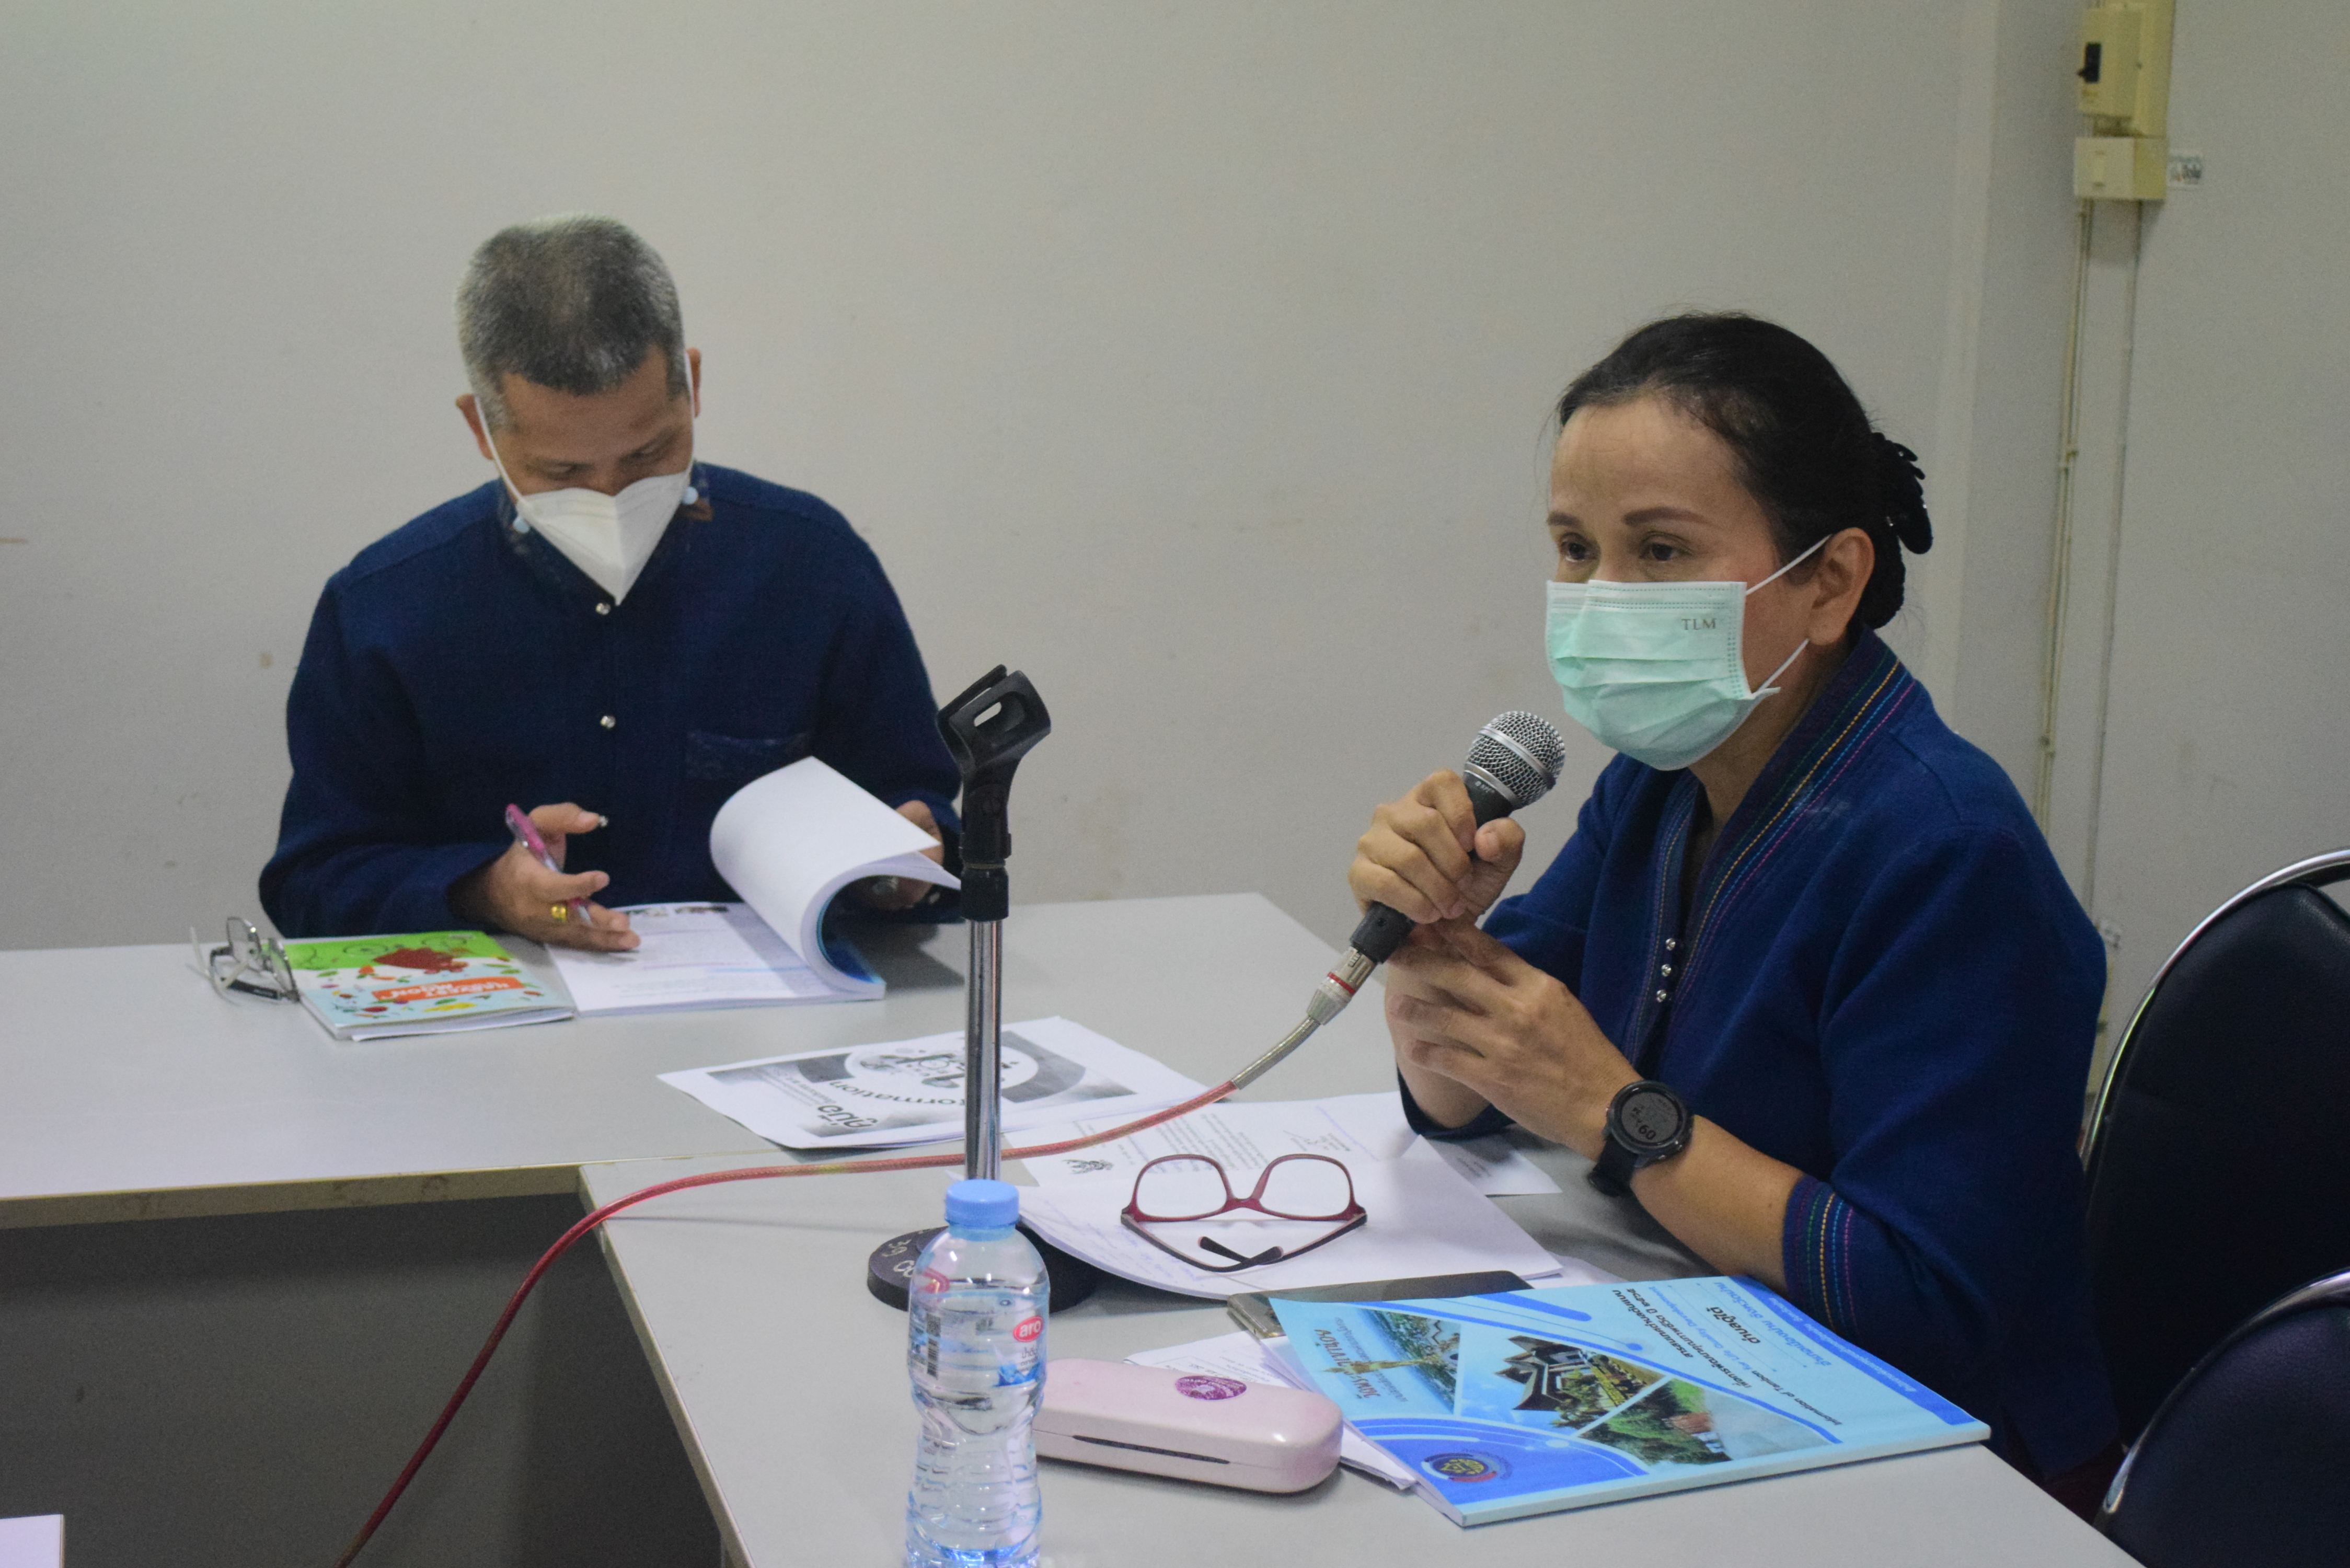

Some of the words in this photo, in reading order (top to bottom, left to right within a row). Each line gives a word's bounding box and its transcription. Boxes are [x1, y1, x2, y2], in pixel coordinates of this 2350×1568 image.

[1681, 618, 1717, 630] TLM
[830, 1081, 965, 1104] ormation
[1652, 1287, 1697, 1327] Development
[1019, 1320, 1042, 1338] aro
[1698, 1328, 1723, 1347] Quality
[1723, 1350, 1740, 1360] Life
[1738, 1361, 1751, 1370] for
[1751, 1370, 1784, 1391] Tambon
[1794, 1398, 1842, 1425] Information
